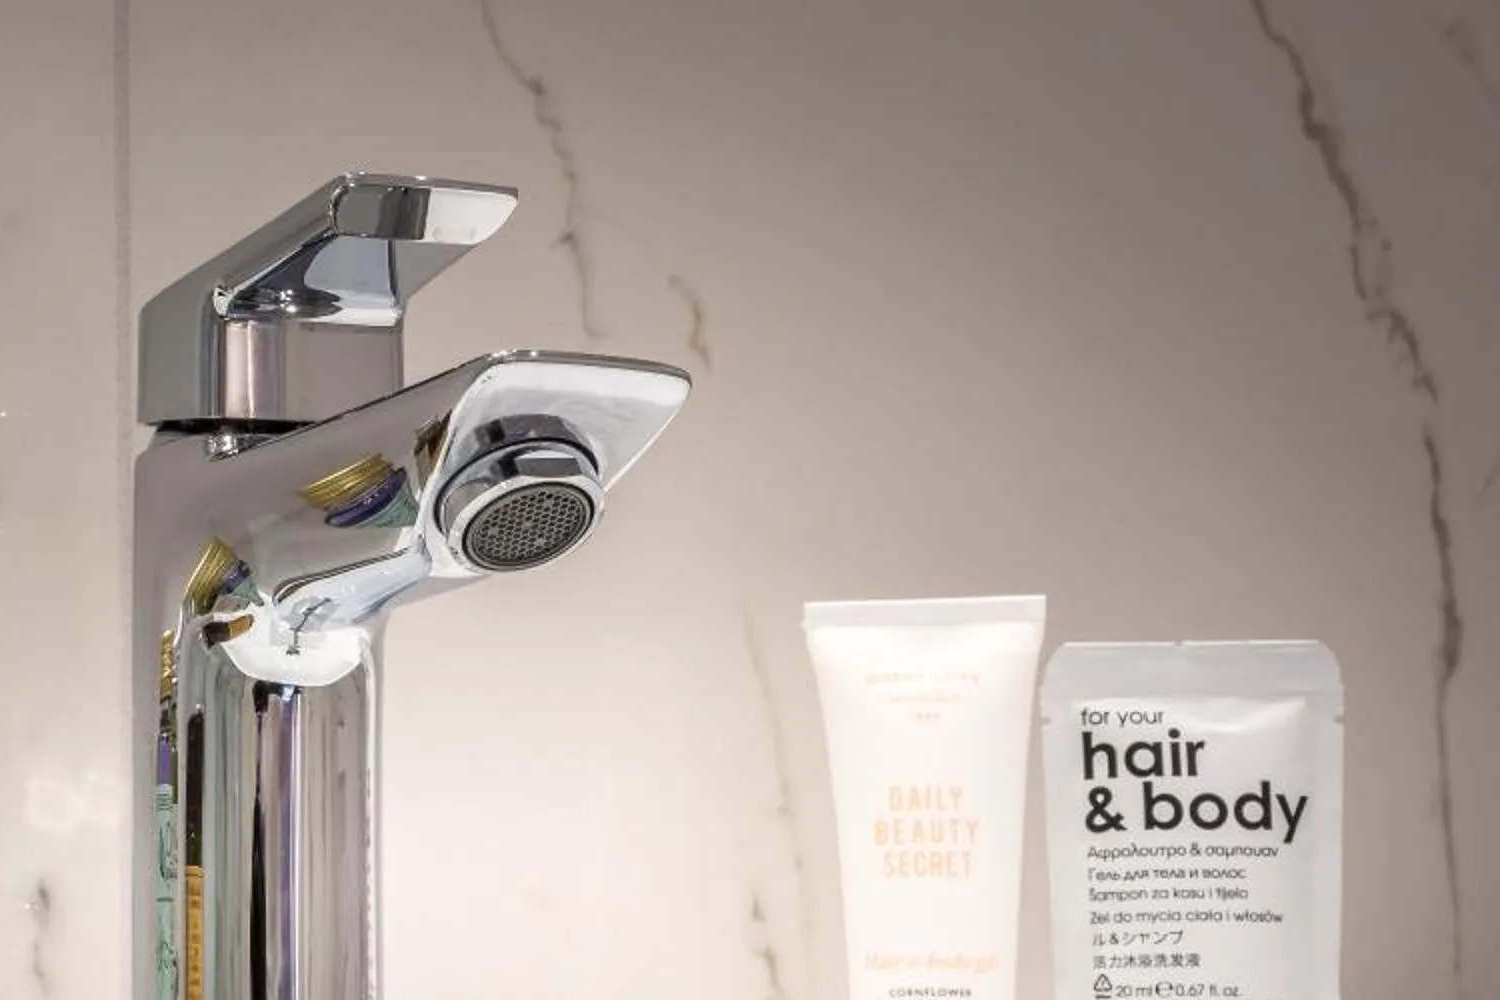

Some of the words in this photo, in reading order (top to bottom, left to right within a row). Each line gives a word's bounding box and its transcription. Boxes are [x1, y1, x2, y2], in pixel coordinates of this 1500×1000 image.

[1081, 709, 1110, 725] for
[1118, 709, 1165, 727] your
[1081, 728, 1205, 780] hair
[888, 783, 963, 812] DAILY
[1085, 785, 1127, 833] &
[1143, 780, 1308, 844] body
[873, 818, 980, 846] BEAUTY
[882, 849, 973, 878] SECRET
[1088, 868, 1121, 882] Гель
[1123, 869, 1150, 881] для
[1153, 869, 1186, 880] тела
[1202, 868, 1248, 880] волос
[1113, 911, 1133, 923] do
[1136, 910, 1182, 926] mycia
